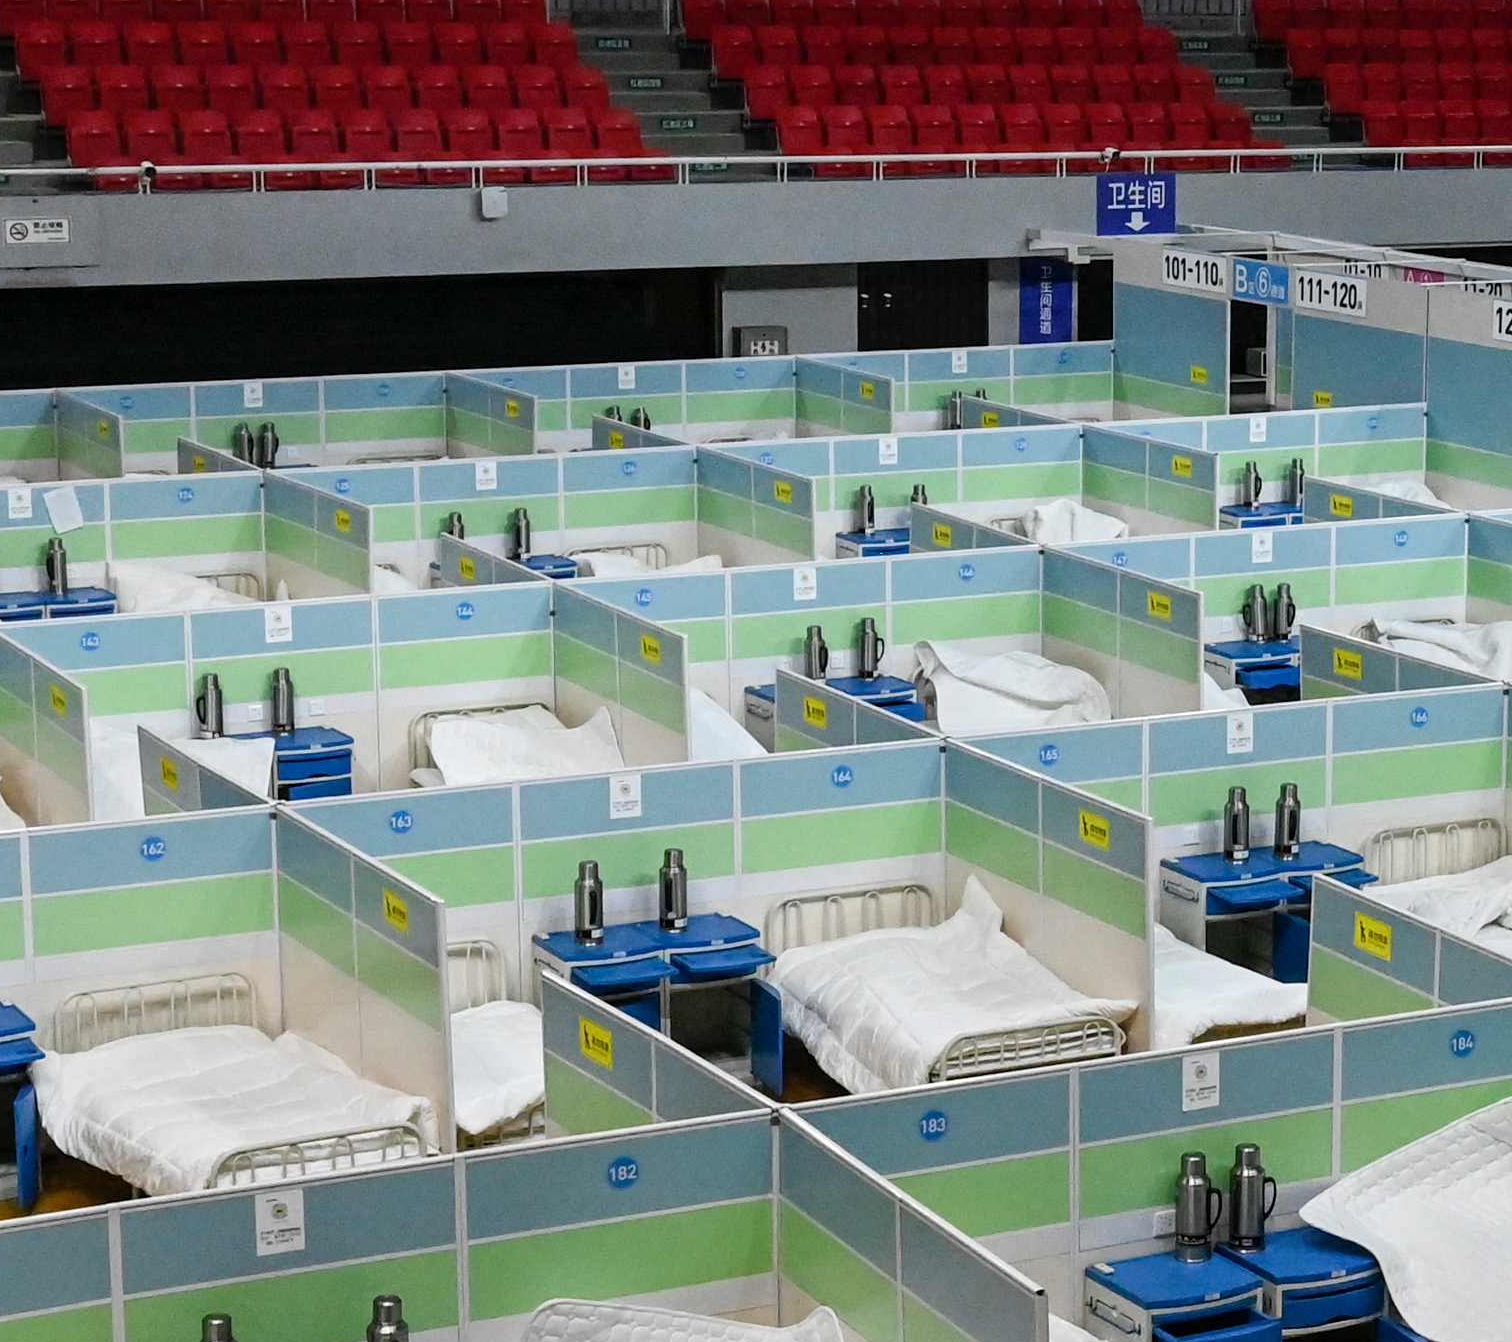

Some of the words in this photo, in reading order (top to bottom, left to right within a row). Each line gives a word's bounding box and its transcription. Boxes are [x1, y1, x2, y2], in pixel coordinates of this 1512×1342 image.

[1107, 182, 1166, 210] 卫生间
[1411, 712, 1428, 723] 166
[1041, 749, 1058, 761] 165
[833, 771, 851, 782] 164
[391, 816, 412, 828] 163
[143, 842, 165, 856] 162
[1452, 1035, 1473, 1051] 184
[922, 1118, 946, 1134] 183
[609, 1164, 637, 1182] 182
